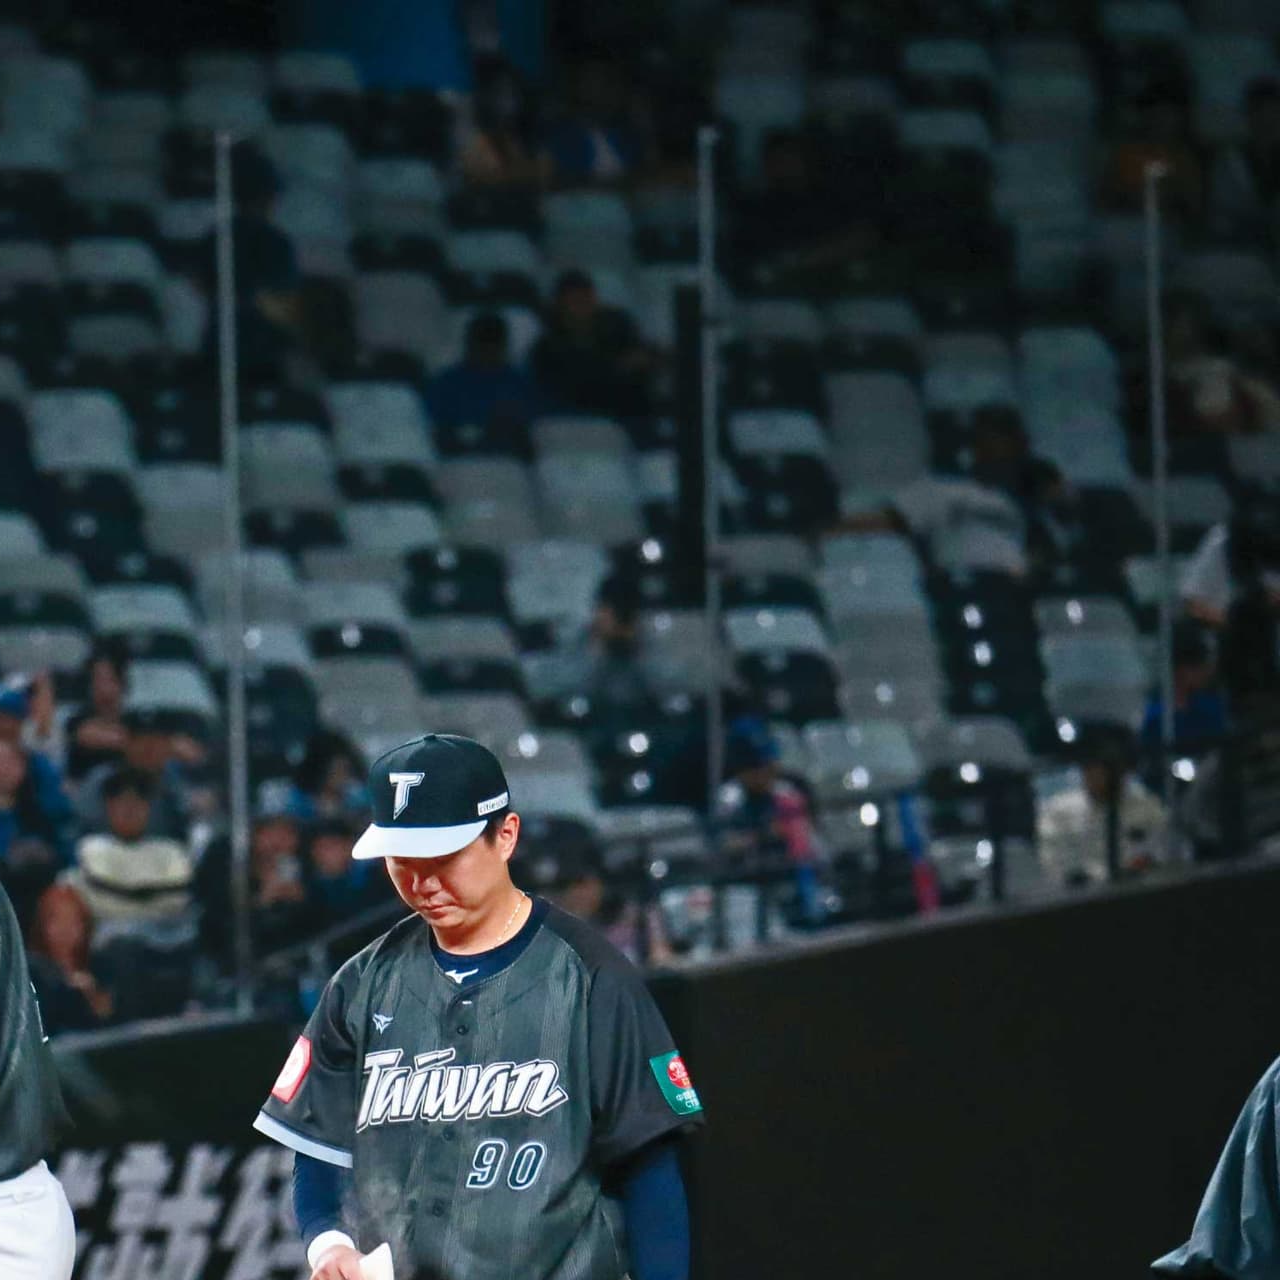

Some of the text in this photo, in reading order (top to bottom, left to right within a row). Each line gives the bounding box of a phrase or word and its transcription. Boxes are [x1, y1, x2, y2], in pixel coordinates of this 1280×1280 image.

[389, 771, 426, 821] T
[355, 1047, 570, 1134] Taiwan
[465, 1140, 549, 1190] 90
